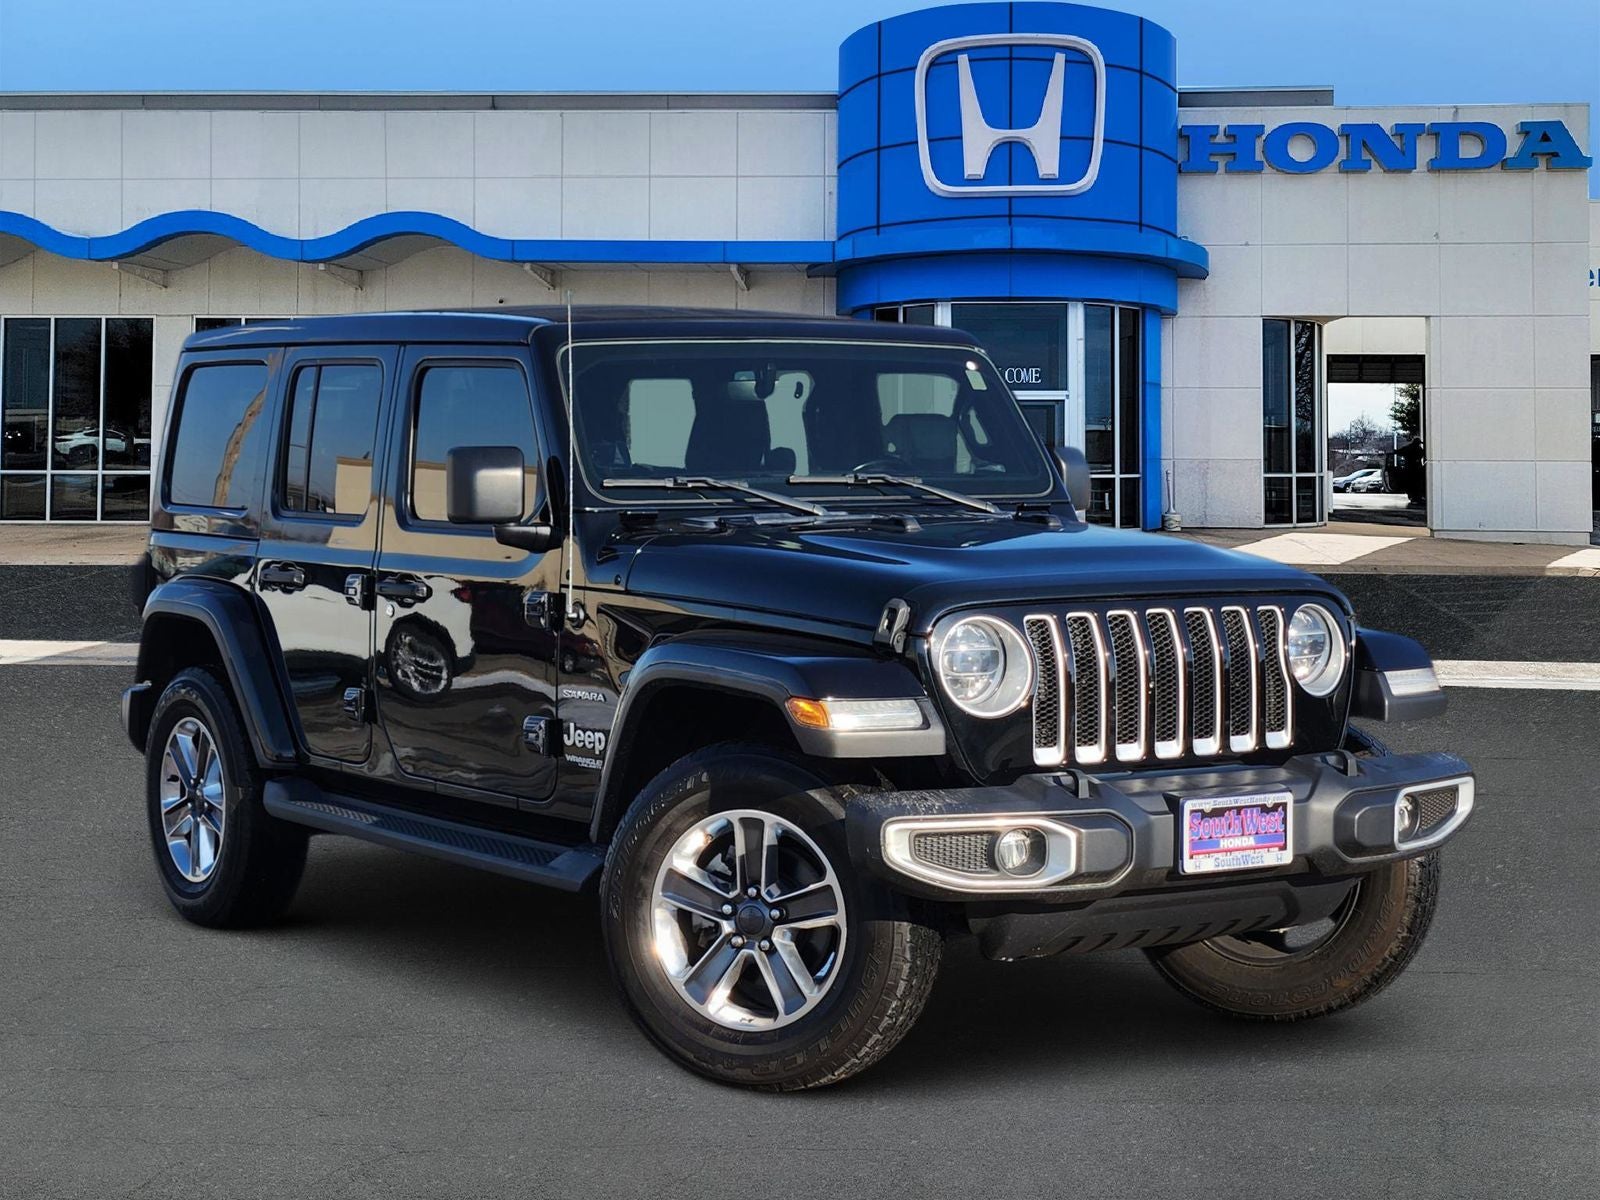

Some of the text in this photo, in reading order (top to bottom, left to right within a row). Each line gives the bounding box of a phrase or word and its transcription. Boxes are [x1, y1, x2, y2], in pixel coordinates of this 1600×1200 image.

[1179, 120, 1593, 174] HONDA
[1003, 367, 1042, 384] COME
[562, 689, 605, 702] SAHARA
[563, 722, 606, 755] Jeep
[1219, 837, 1256, 848] HONDA
[1214, 854, 1265, 868] SouthWest
